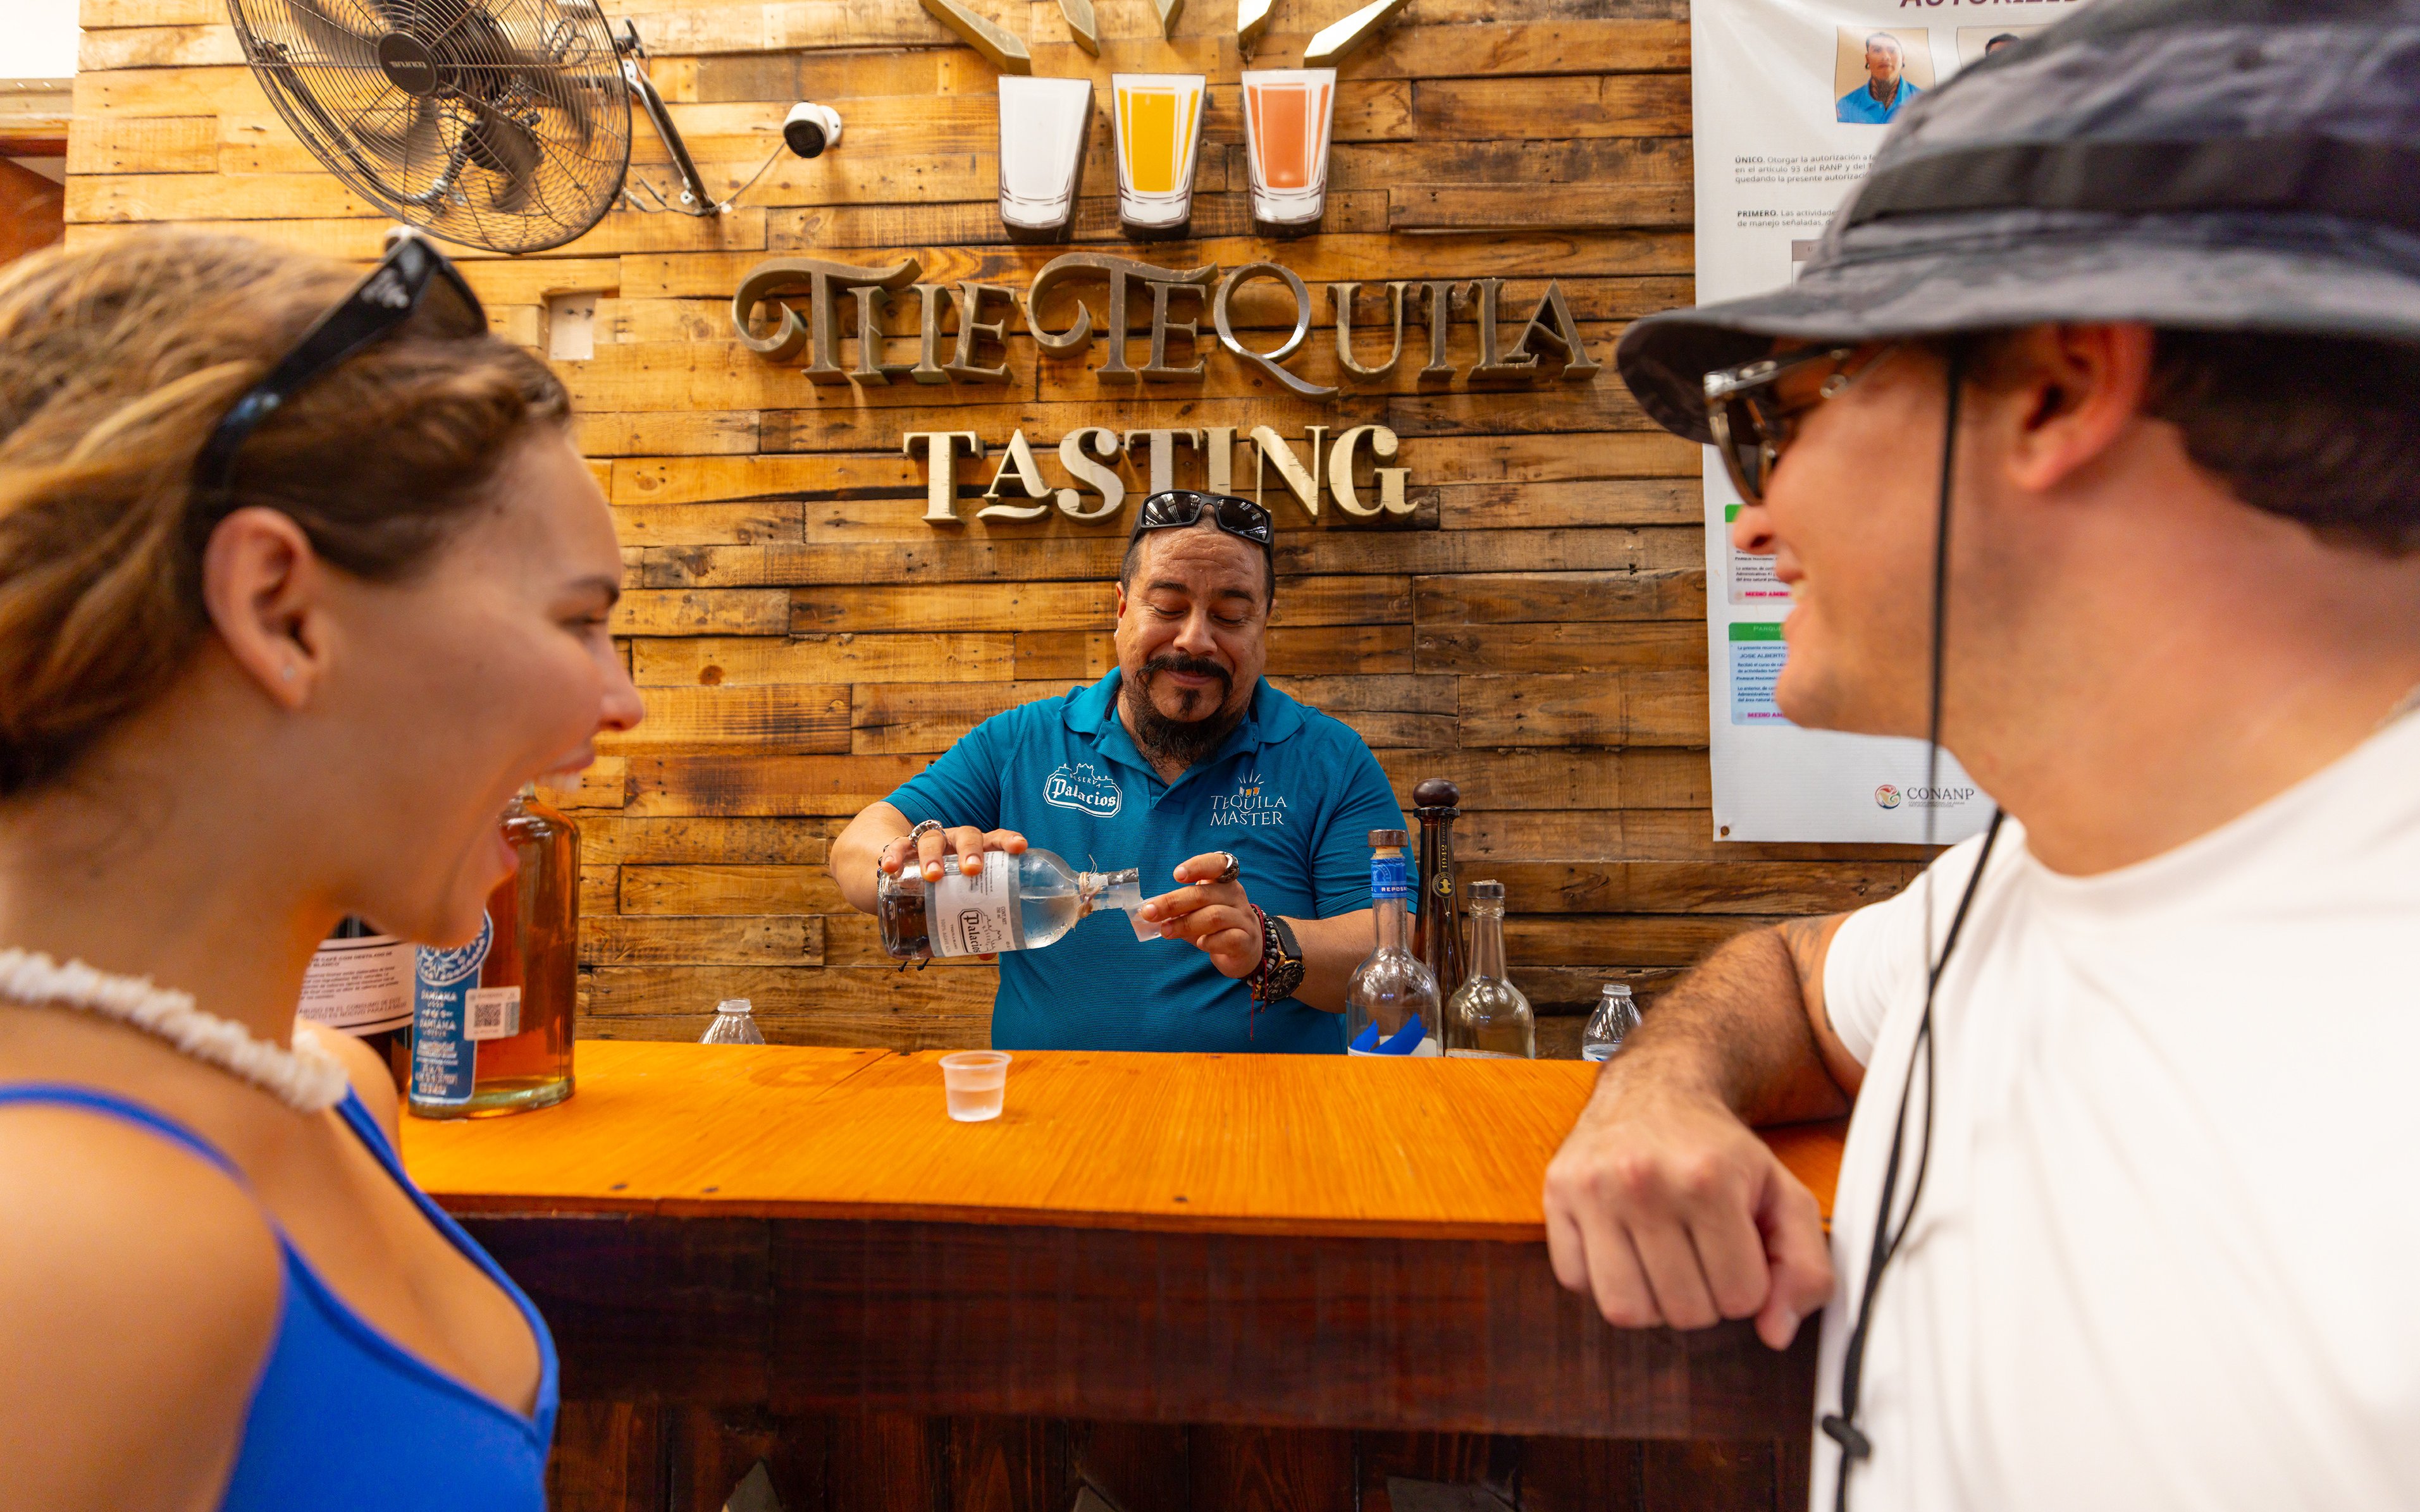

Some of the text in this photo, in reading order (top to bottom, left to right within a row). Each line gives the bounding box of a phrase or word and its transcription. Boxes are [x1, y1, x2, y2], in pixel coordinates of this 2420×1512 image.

[1735, 155, 1765, 163] ÚNICO.
[1767, 156, 1798, 165] Otorgar
[1810, 154, 1861, 162] autorización
[1820, 163, 1843, 171] RANP
[1735, 175, 1776, 184] quedando
[1787, 175, 1822, 184] presente
[1738, 209, 1779, 218] PRIMERO.
[1750, 220, 1780, 228] manejo
[732, 253, 1602, 401] THE TEQUILA
[903, 425, 1419, 524] TASTING
[1070, 772, 1101, 789] RESERVA
[1051, 778, 1116, 808] Palacios
[1906, 787, 1974, 800] CONANP
[1211, 794, 1288, 814] TEQUILA
[1210, 811, 1285, 826] MASTER
[963, 913, 982, 953] Palacios
